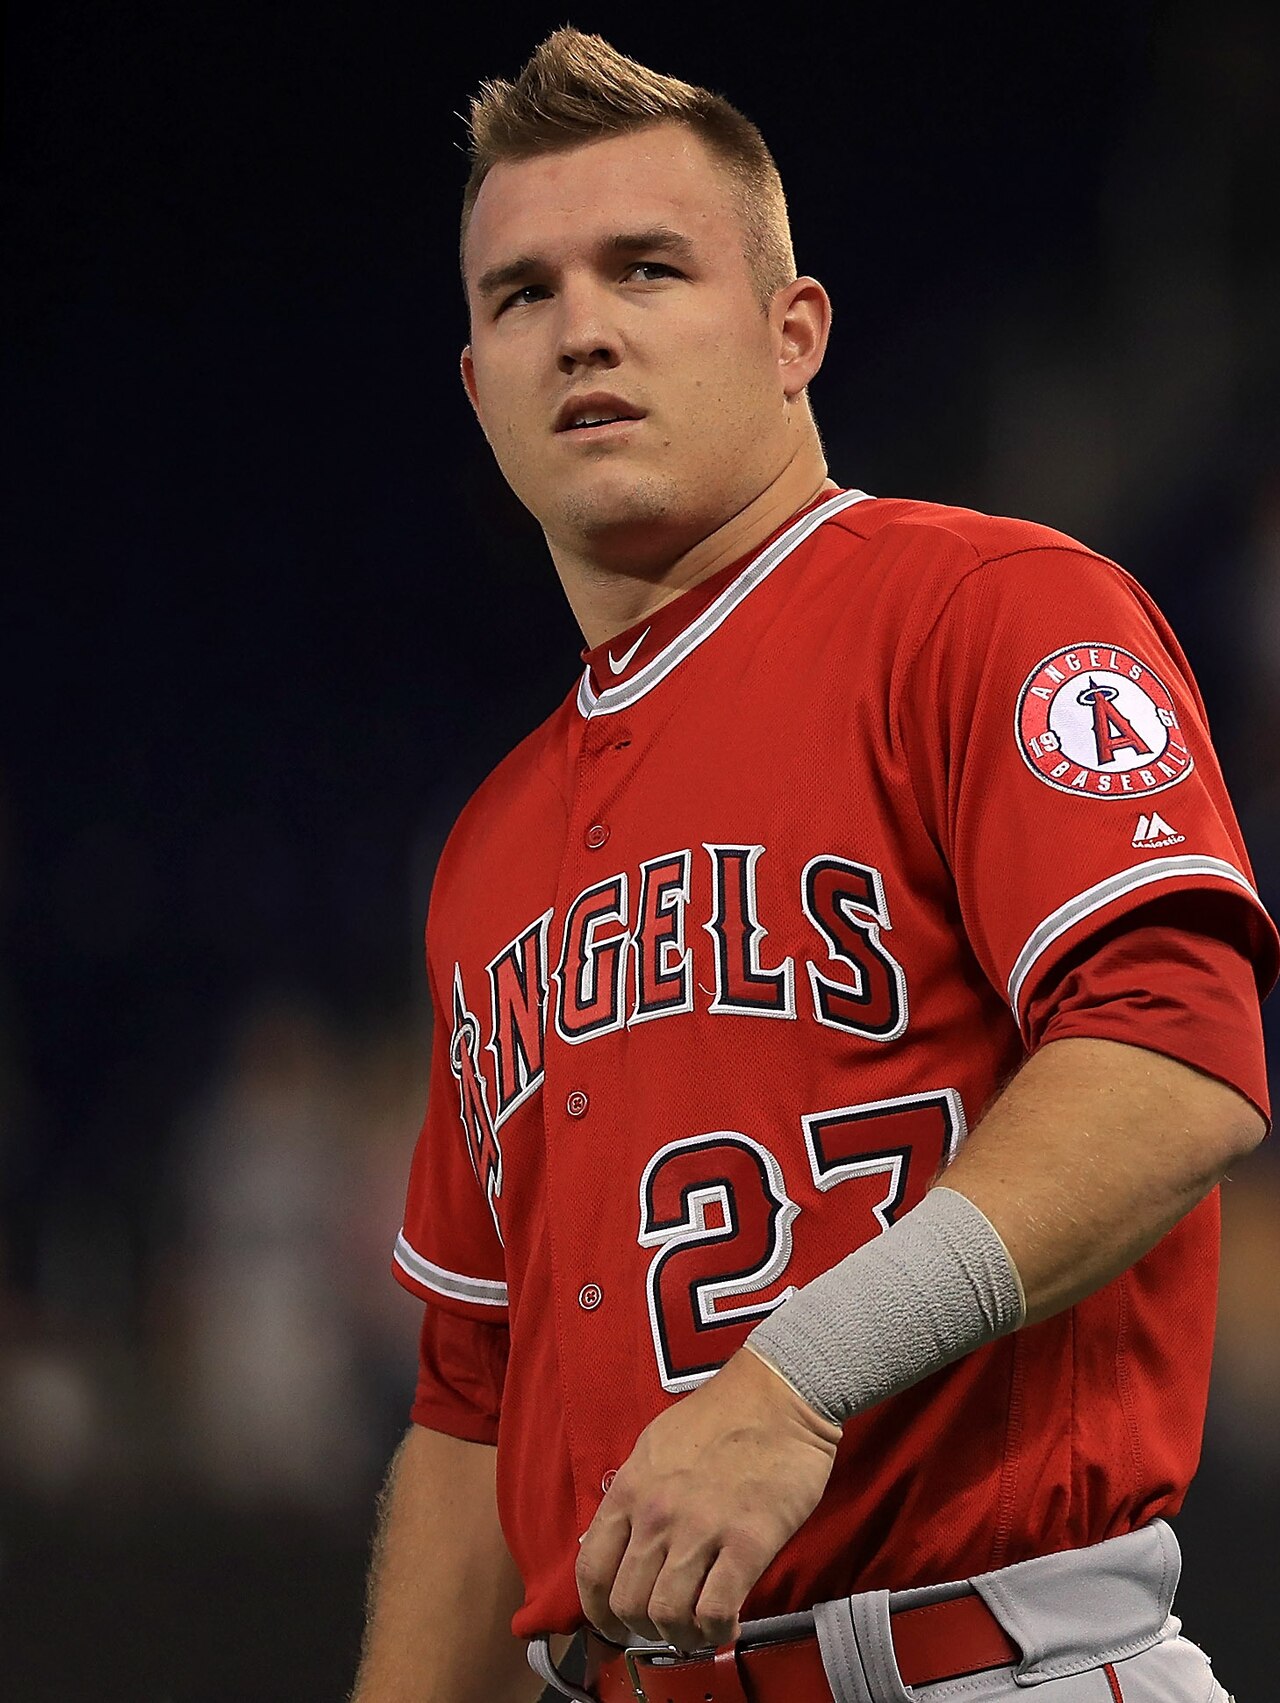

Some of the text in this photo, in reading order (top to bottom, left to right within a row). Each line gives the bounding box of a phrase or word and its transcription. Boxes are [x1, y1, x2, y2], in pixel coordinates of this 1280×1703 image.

[1030, 649, 1143, 701] ANGELS
[1028, 730, 1061, 758] 19
[1077, 676, 1154, 766] A
[1157, 707, 1179, 730] 61
[1050, 740, 1188, 791] BASEBALL
[449, 843, 910, 1248] ANGELS
[637, 1088, 969, 1393] 27
